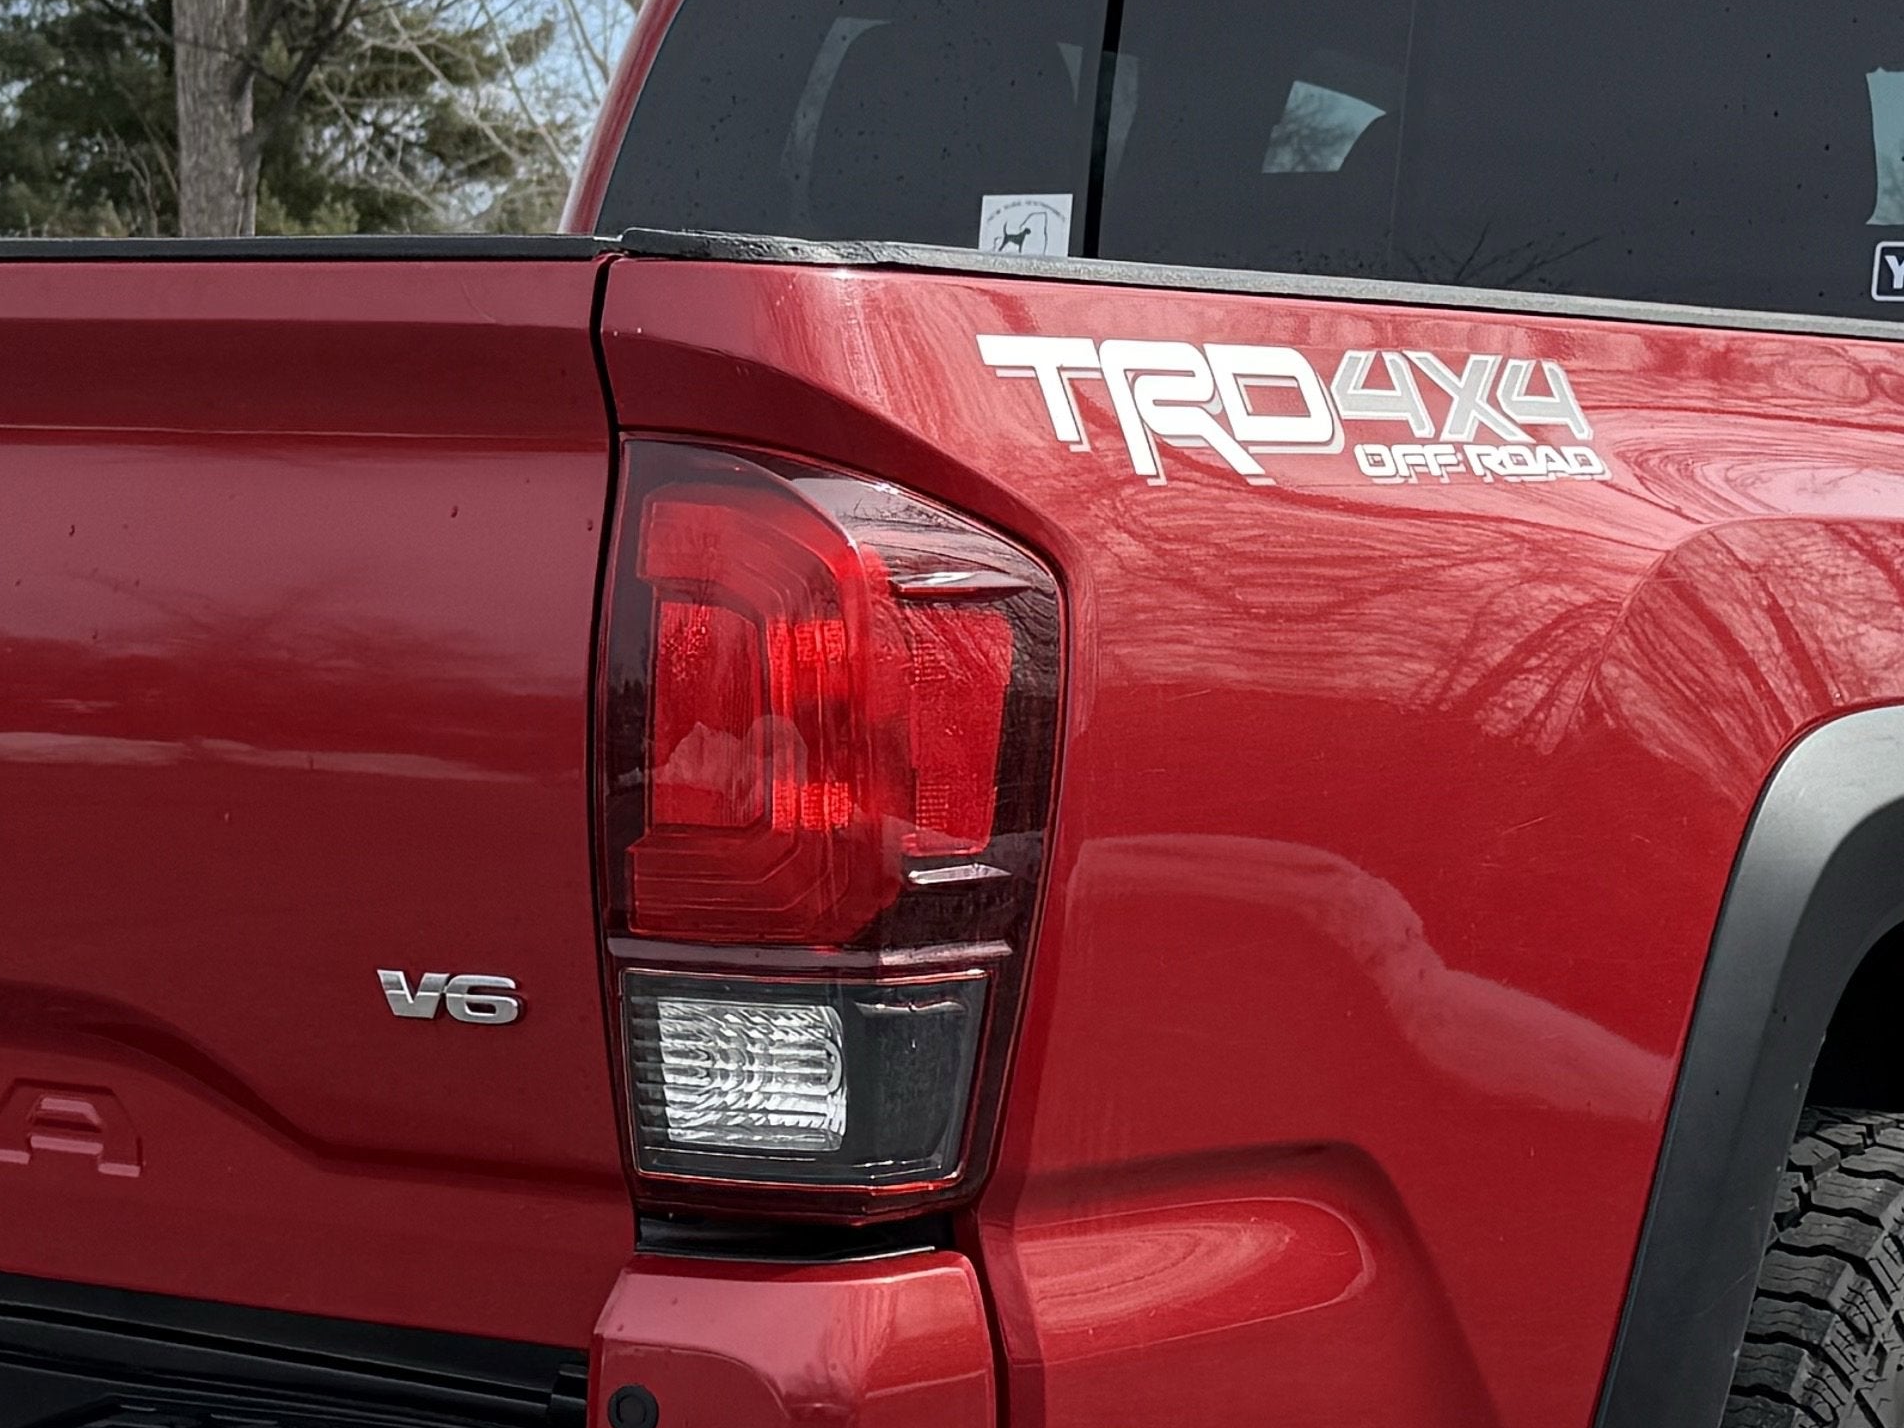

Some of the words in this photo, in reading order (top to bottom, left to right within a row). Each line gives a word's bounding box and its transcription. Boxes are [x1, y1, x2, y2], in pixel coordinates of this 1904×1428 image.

[976, 333, 1340, 484] TRD
[1353, 443, 1462, 481] OFF
[1462, 443, 1608, 480] ROAD
[377, 969, 519, 1024] V6
